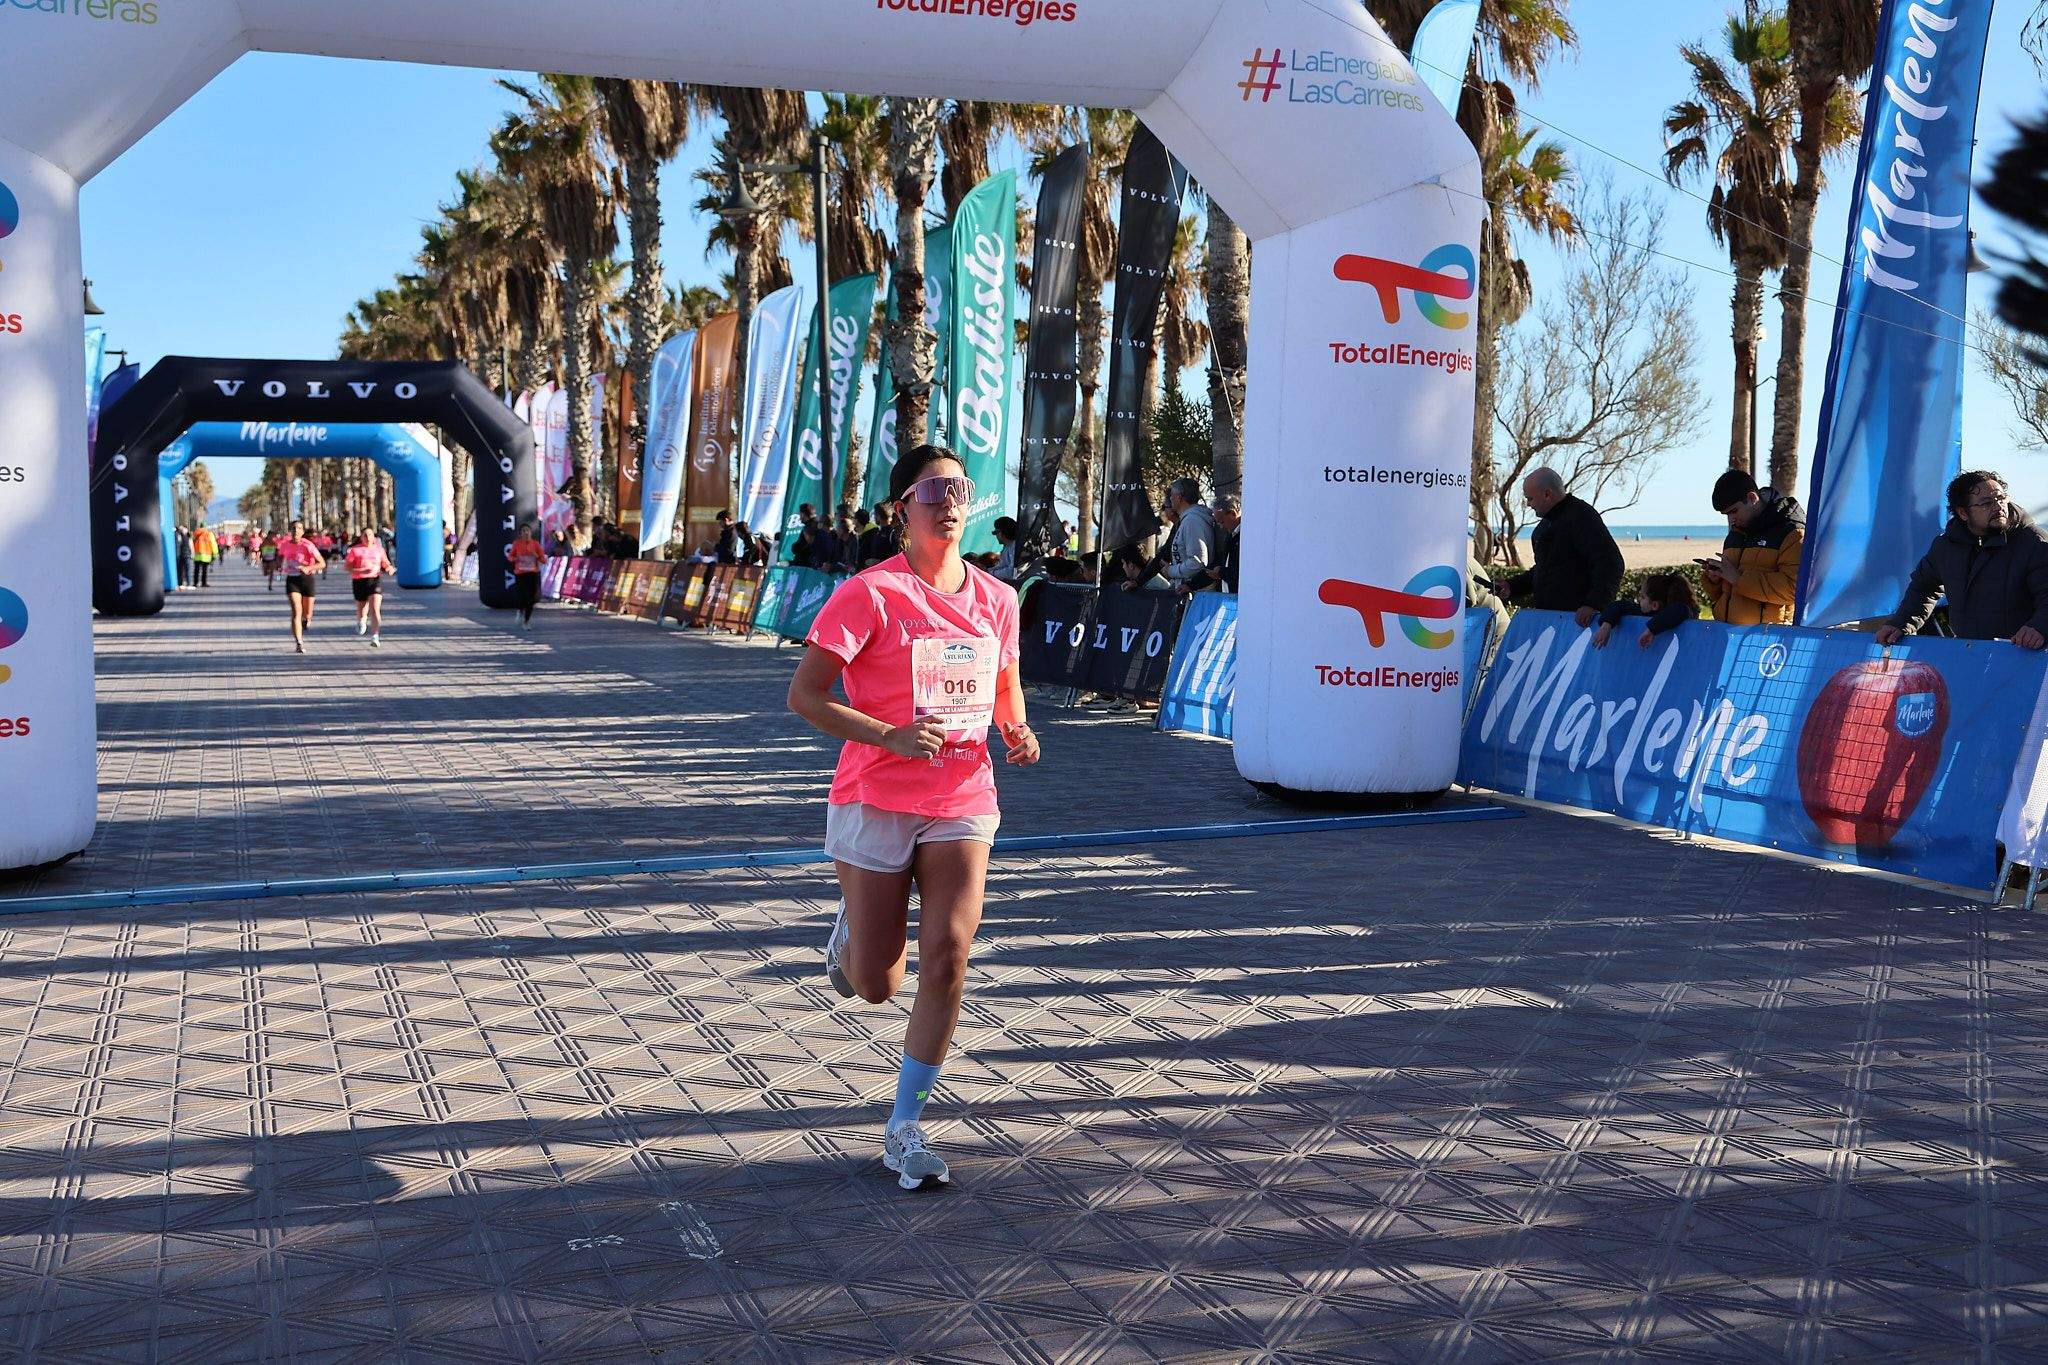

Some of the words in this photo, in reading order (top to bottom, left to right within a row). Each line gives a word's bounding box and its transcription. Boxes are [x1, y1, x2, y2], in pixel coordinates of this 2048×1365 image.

[1861, 0, 1963, 290] Marlen
[957, 232, 1005, 459] Batiste
[1329, 342, 1473, 374] TotalEnergies
[213, 379, 418, 399] VOLVO
[239, 421, 328, 453] Marlene
[1324, 466, 1467, 488] totalenergies.es
[113, 454, 133, 594] VOLVO
[1045, 620, 1163, 658] VOLVO
[944, 679, 977, 694] 016
[1315, 665, 1459, 693] TotalEnergies
[1480, 625, 1769, 813] Marlene
